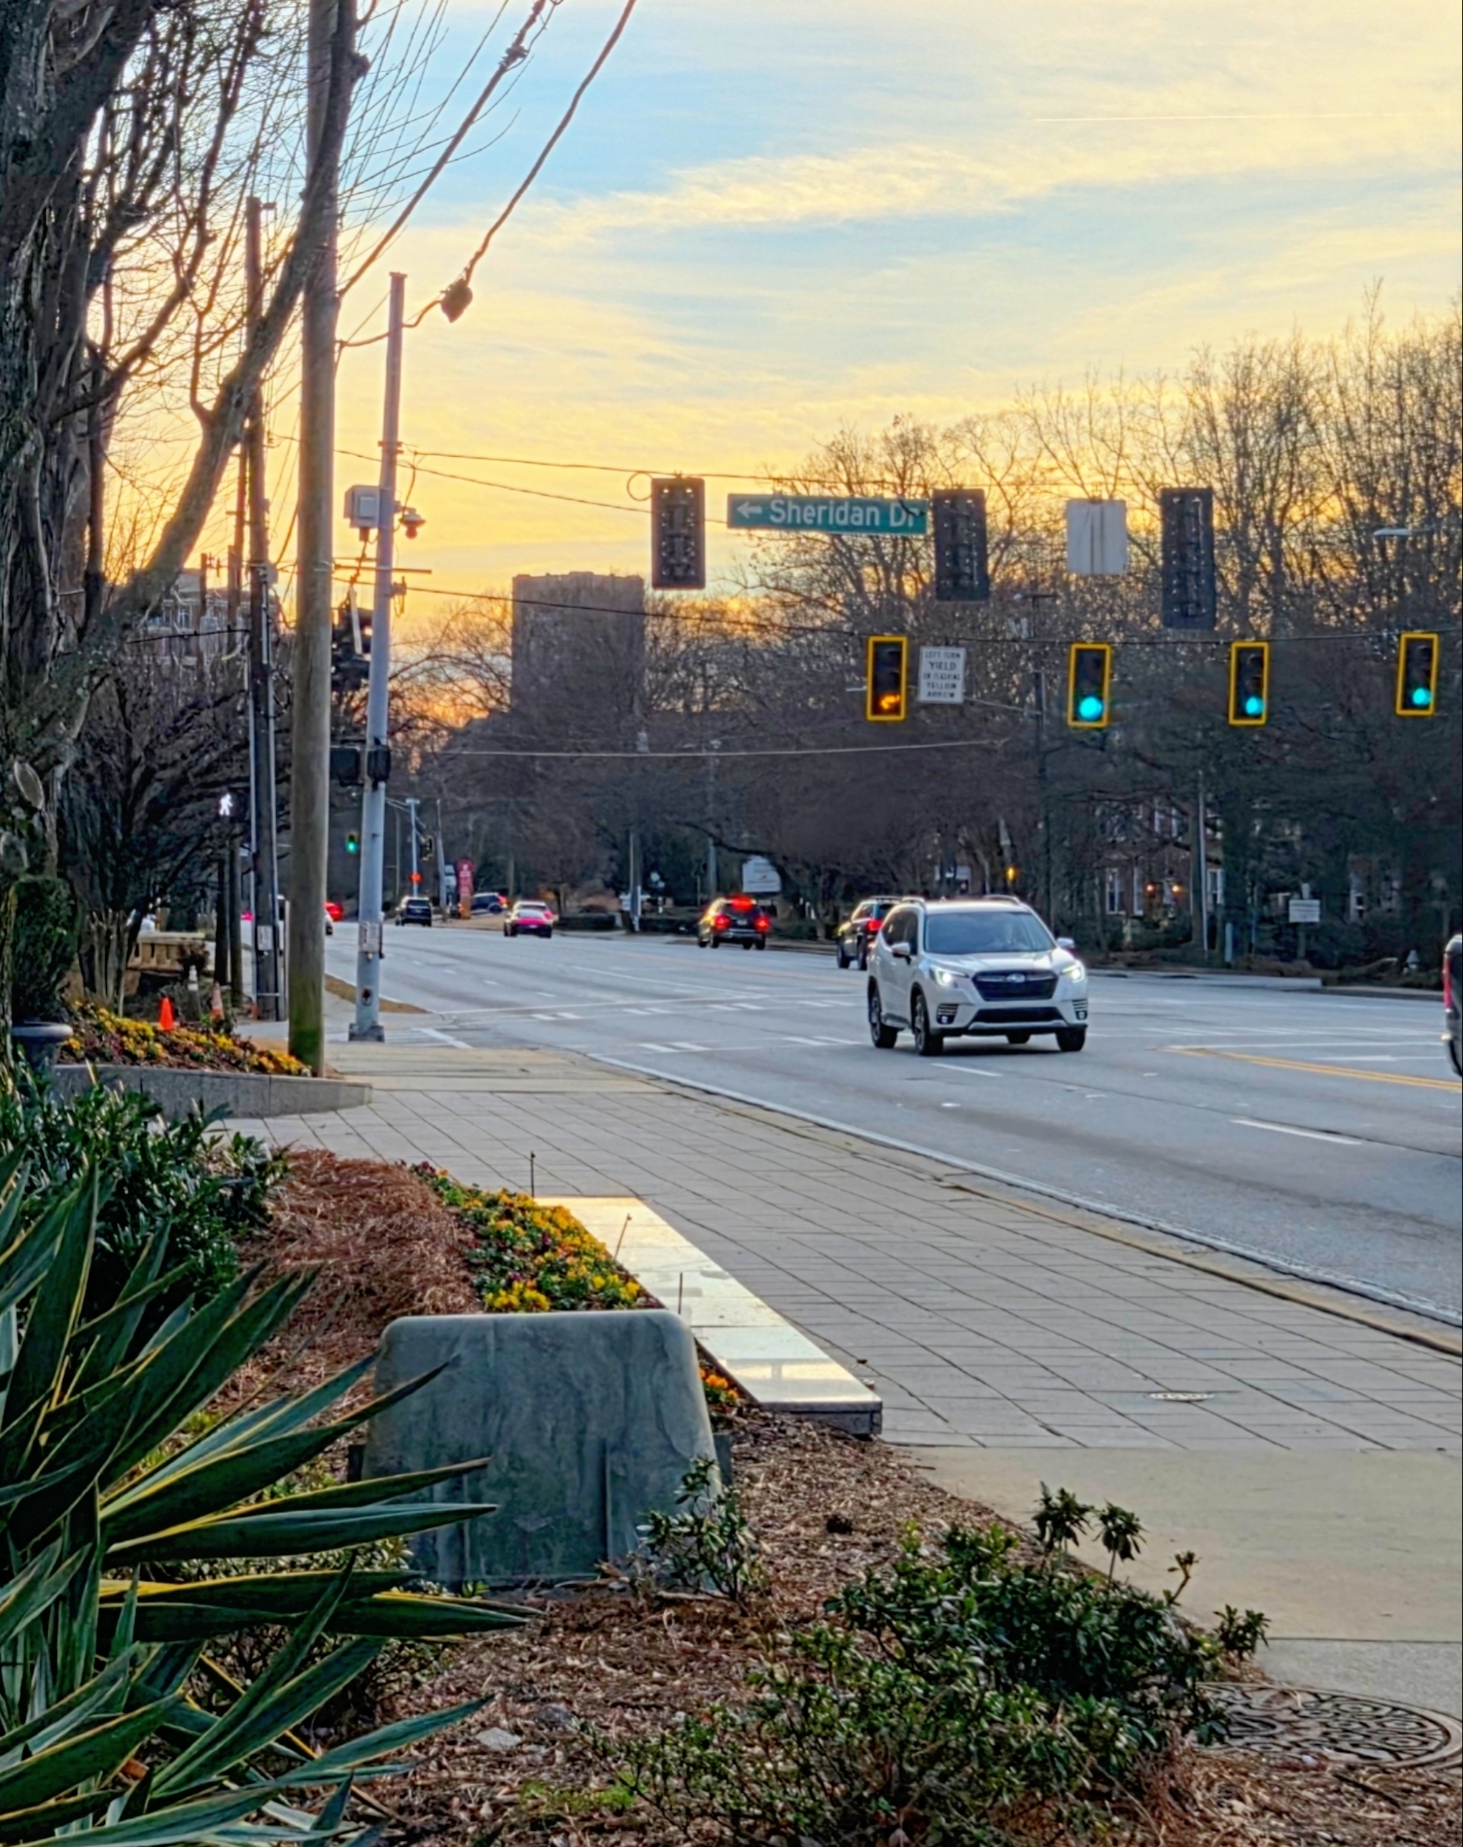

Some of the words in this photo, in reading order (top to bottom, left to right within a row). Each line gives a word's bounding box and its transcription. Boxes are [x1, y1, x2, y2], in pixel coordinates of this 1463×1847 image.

[769, 499, 880, 527] Sheridan
[889, 502, 920, 528] Dr
[928, 661, 957, 671] YIELD
